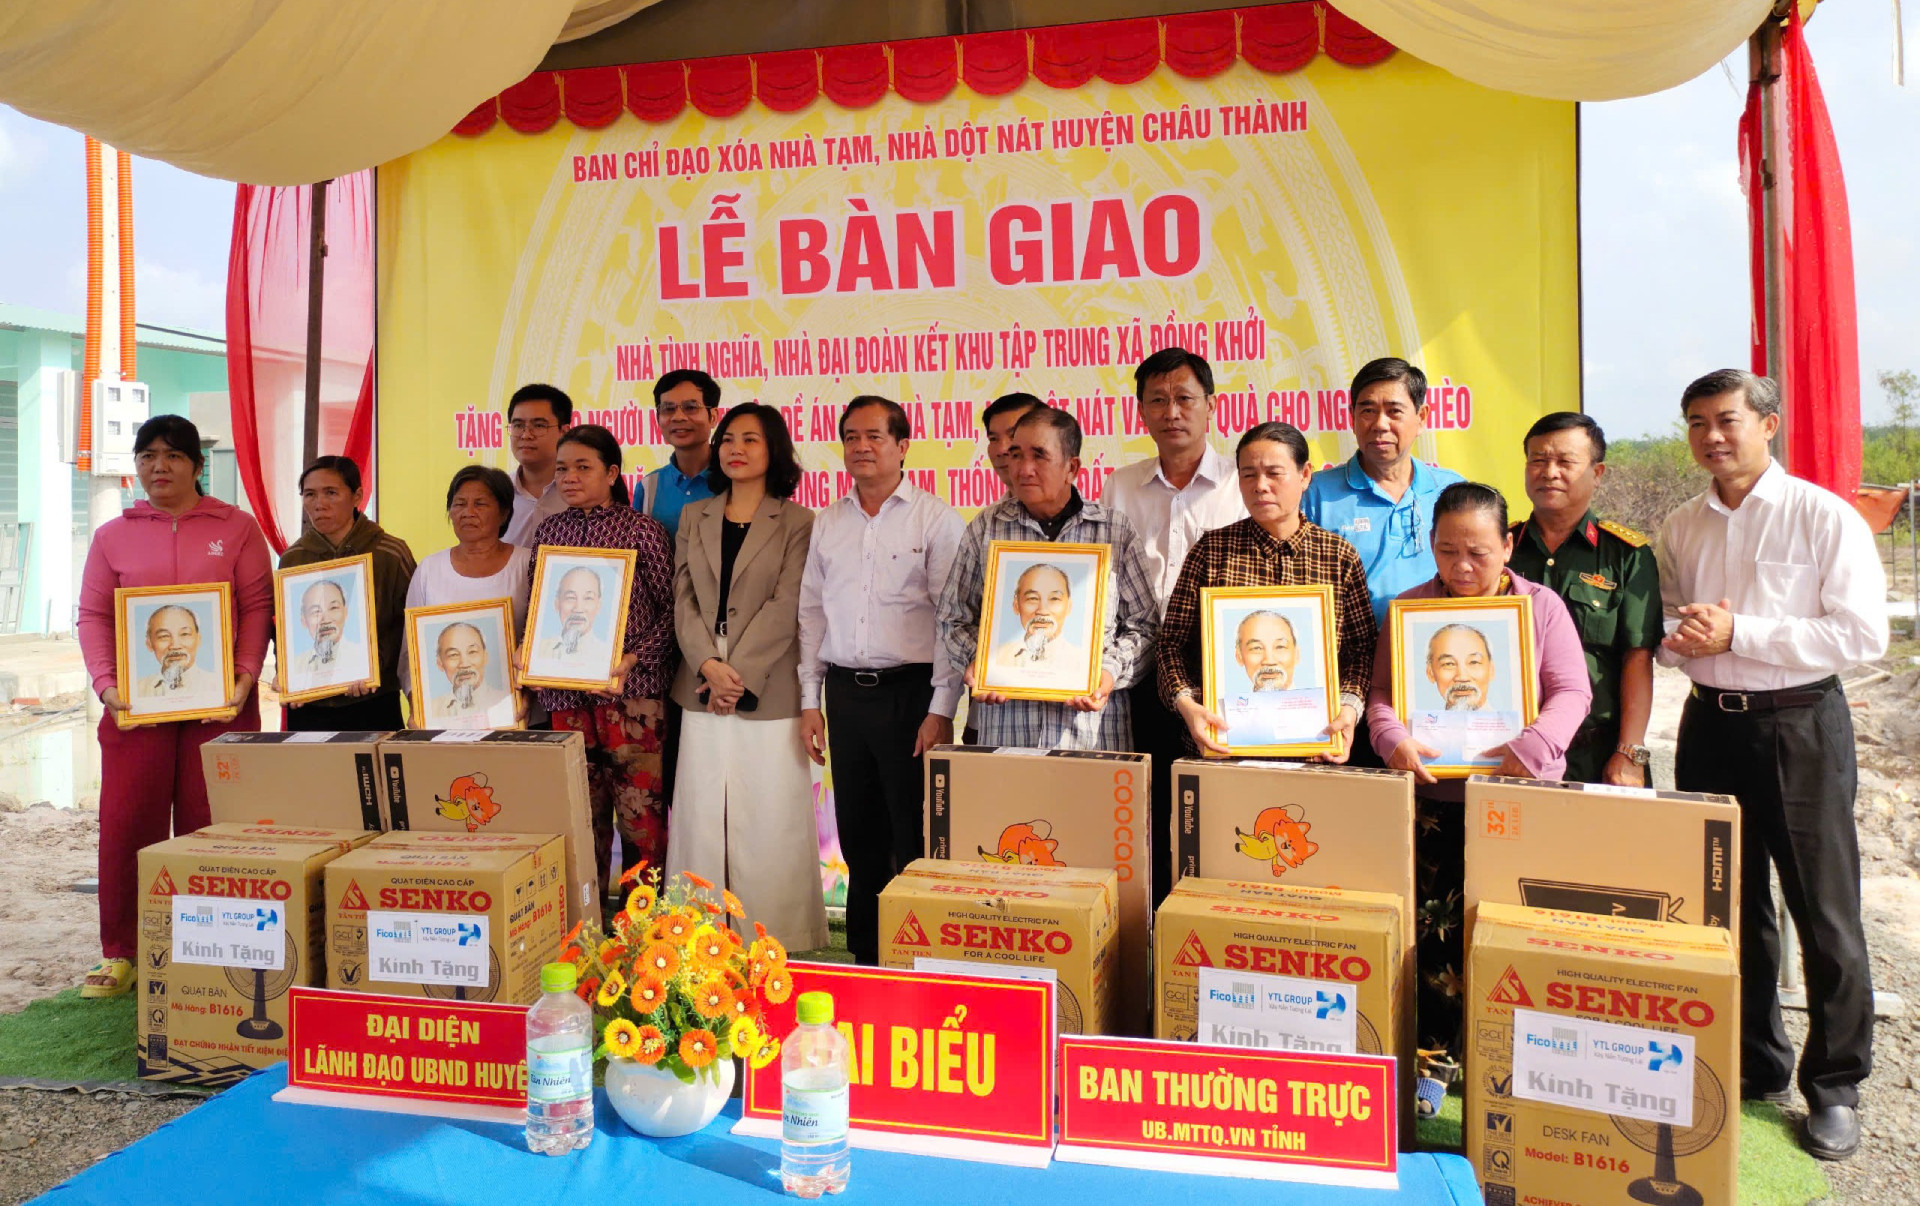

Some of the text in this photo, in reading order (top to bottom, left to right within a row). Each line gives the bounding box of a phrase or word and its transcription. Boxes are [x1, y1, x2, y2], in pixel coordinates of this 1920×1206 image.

[573, 99, 1307, 182] BAN CHỈ ĐẠO XÓA NHÀ TẠM, NHÀ DỘT NÁT HUYỆN CHÂU THÀNH
[659, 193, 1200, 300] LỄ BÀN GIAO
[617, 306, 1264, 383] NHÀ TÌNH NGHĨA, NHÀ ĐẠI ĐOÀN KẾT KHU TẬP TRUNG XÃ ĐỒNG KHỞI
[456, 405, 502, 456] TẶNG
[811, 396, 836, 442] ÁN
[931, 401, 978, 447] TẠM,
[1077, 389, 1115, 435] NÁT
[1216, 384, 1259, 438] QUÀ
[1266, 390, 1310, 432] CHO
[935, 788, 943, 817] YouTube
[1184, 804, 1192, 834] YouTube
[188, 875, 292, 901] SENKO
[379, 888, 493, 912] SENKO
[930, 884, 1049, 899] SENKO
[532, 901, 552, 923] B1616
[948, 911, 1059, 926] HIGH QUALITY ELECTRIC FAN
[1210, 905, 1341, 921] SENKO
[421, 927, 433, 935] YTL
[434, 927, 456, 936] GROUP
[939, 922, 1073, 955] SENKO
[1234, 932, 1356, 951] HIGH QUALITY ELECTRIC FAN
[230, 944, 275, 965] Tặng
[964, 950, 984, 959] FOR
[994, 952, 1021, 961] COOL
[1023, 954, 1045, 963] LIFE
[1526, 937, 1675, 961] SENKO
[430, 960, 479, 981] Tặng
[1224, 944, 1371, 982] SENKO
[1557, 969, 1698, 994] HIGH QUALITY ELECTRIC FAN
[209, 1003, 244, 1017] B1616
[1268, 991, 1283, 1002] YTL
[1284, 994, 1313, 1005] GROUP
[1546, 981, 1715, 1028] SENKO
[367, 1013, 480, 1048] ĐẠI DIỆN
[891, 1005, 995, 1096] BIỂU
[1593, 1039, 1610, 1051] YTL
[1612, 1042, 1644, 1055] GROUP
[304, 1044, 528, 1097] LÃNH ĐẠO UBND HUYỆ
[542, 1076, 572, 1087] Nhiên
[1079, 1065, 1371, 1126] BAN THƯỜNG TRỰC
[1528, 1070, 1676, 1118] Kính Tặng
[790, 1114, 818, 1127] Nhiên
[1142, 1120, 1305, 1151] UB.MTTQ.VN TỈNH
[1543, 1126, 1610, 1147] DESK FAN
[1524, 1147, 1569, 1164] Model:
[1573, 1151, 1630, 1174] B1616
